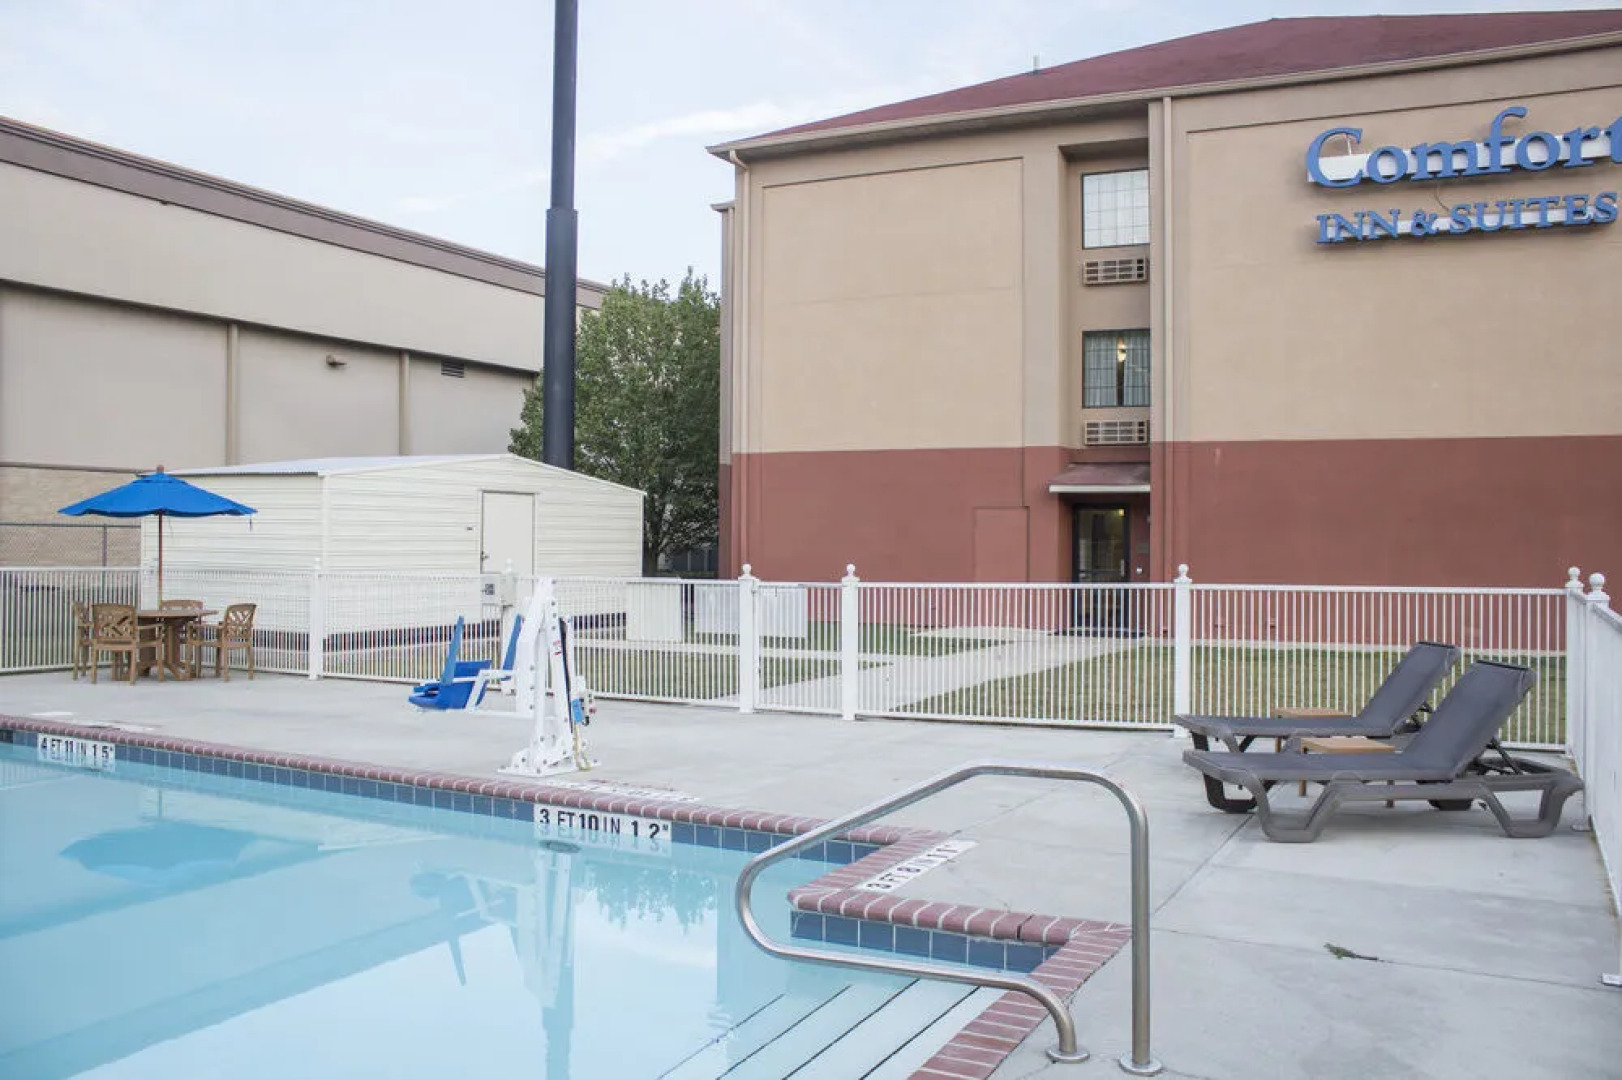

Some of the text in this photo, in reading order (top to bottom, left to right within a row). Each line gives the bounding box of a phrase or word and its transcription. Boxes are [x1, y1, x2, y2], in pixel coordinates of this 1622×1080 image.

[1316, 191, 1618, 243] INN & SUITES
[539, 808, 550, 825] 3
